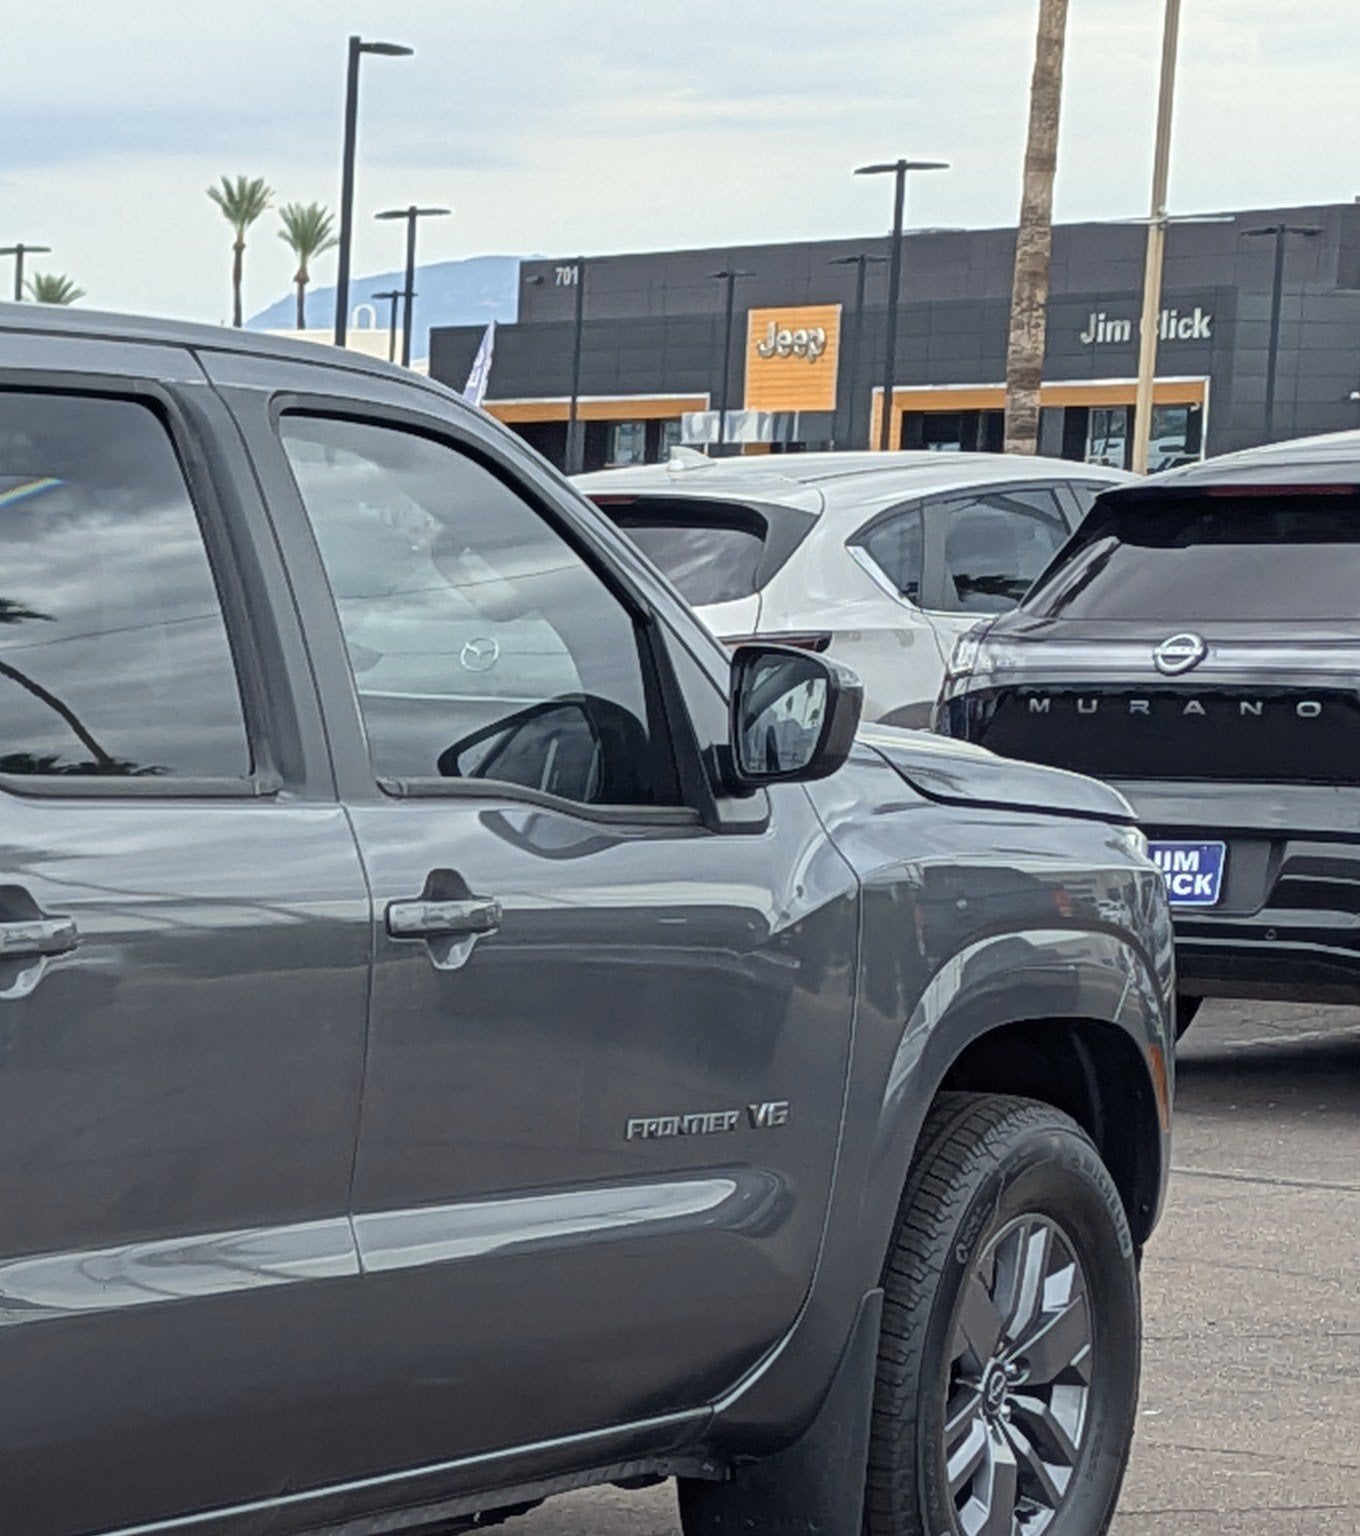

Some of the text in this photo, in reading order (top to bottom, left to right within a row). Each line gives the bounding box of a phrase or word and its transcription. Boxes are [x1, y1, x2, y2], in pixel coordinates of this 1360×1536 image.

[555, 266, 579, 286] 701
[757, 320, 826, 363] Jeep
[1080, 307, 1212, 344] Jim lick
[1029, 698, 1322, 718] MURANO
[626, 1100, 789, 1141] FRONTIER V6
